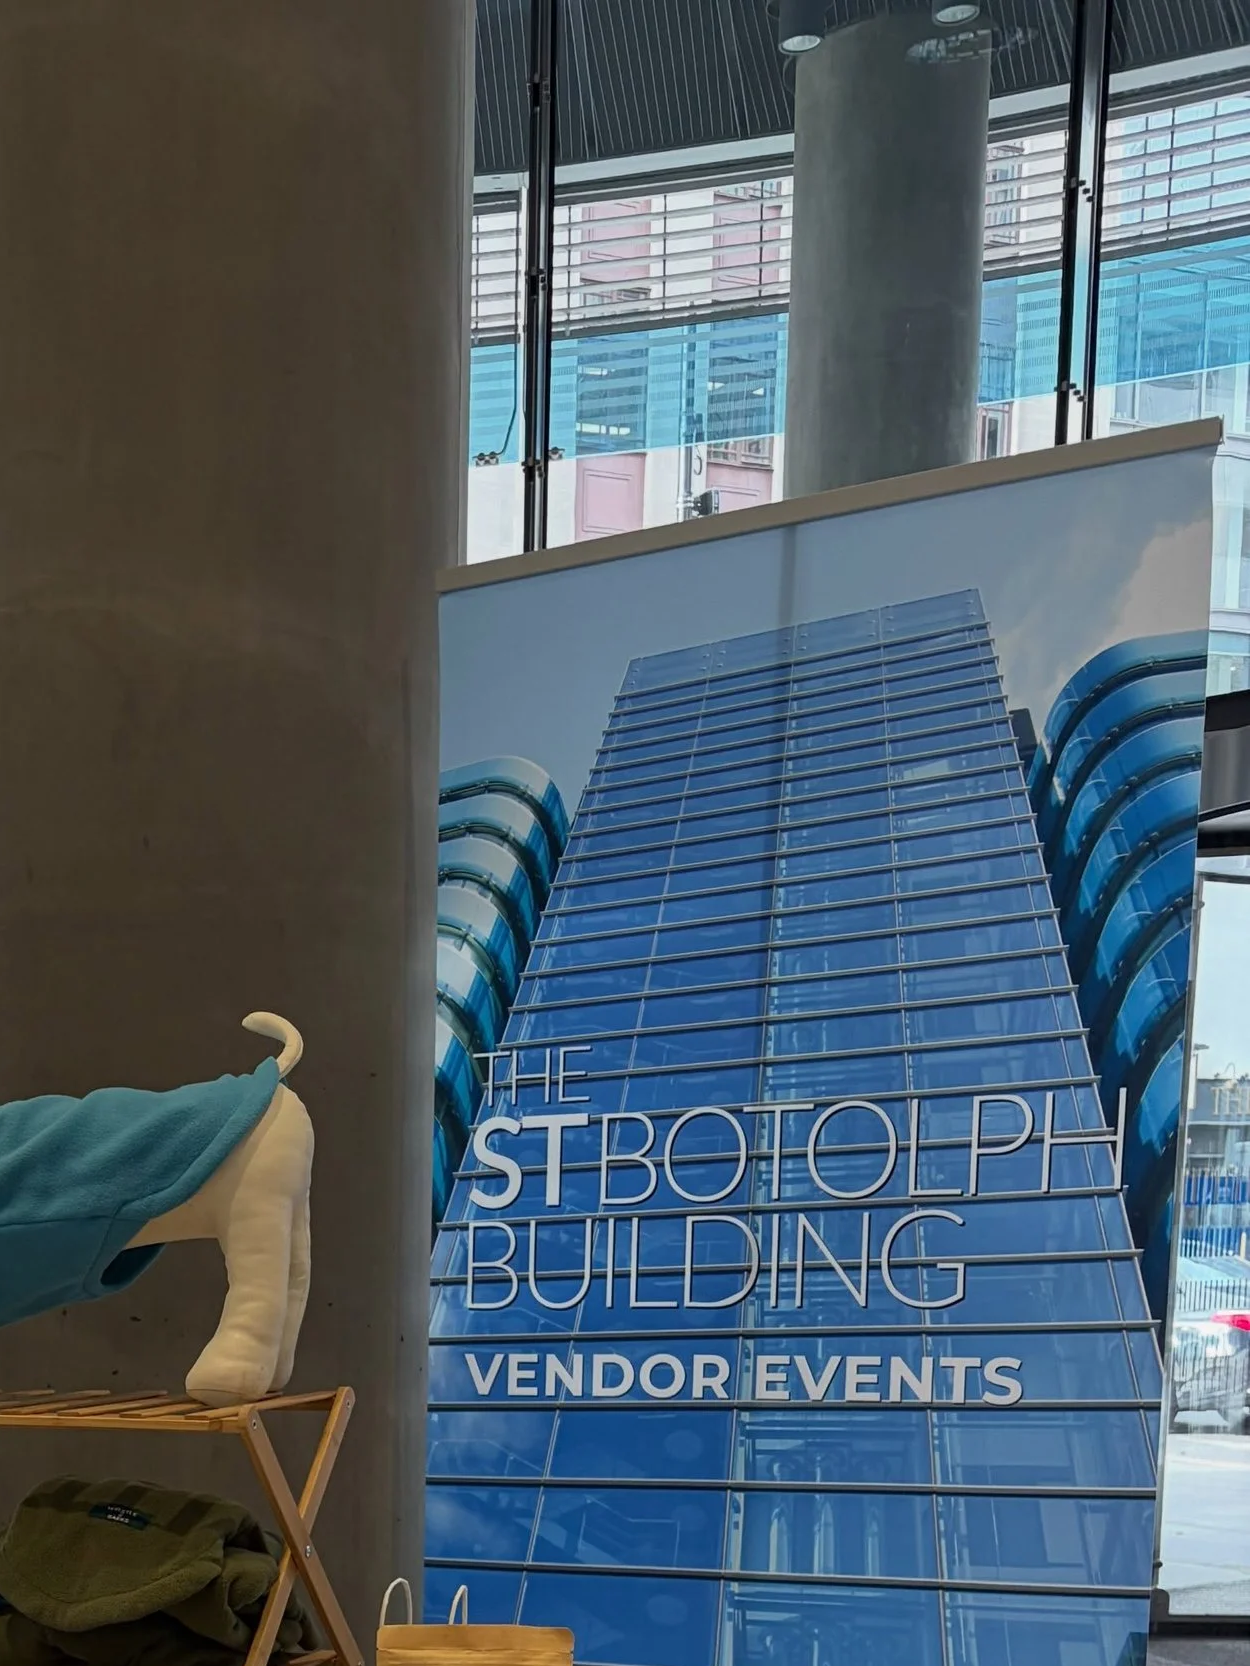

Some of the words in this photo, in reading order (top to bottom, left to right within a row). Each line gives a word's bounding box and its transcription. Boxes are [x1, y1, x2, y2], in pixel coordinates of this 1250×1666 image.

[474, 1045, 591, 1106] THE
[1211, 1086, 1250, 1116] TH
[466, 1209, 966, 1311] BUILDING
[465, 1352, 730, 1399] VENDOR
[755, 1355, 1023, 1405] EVENTS
